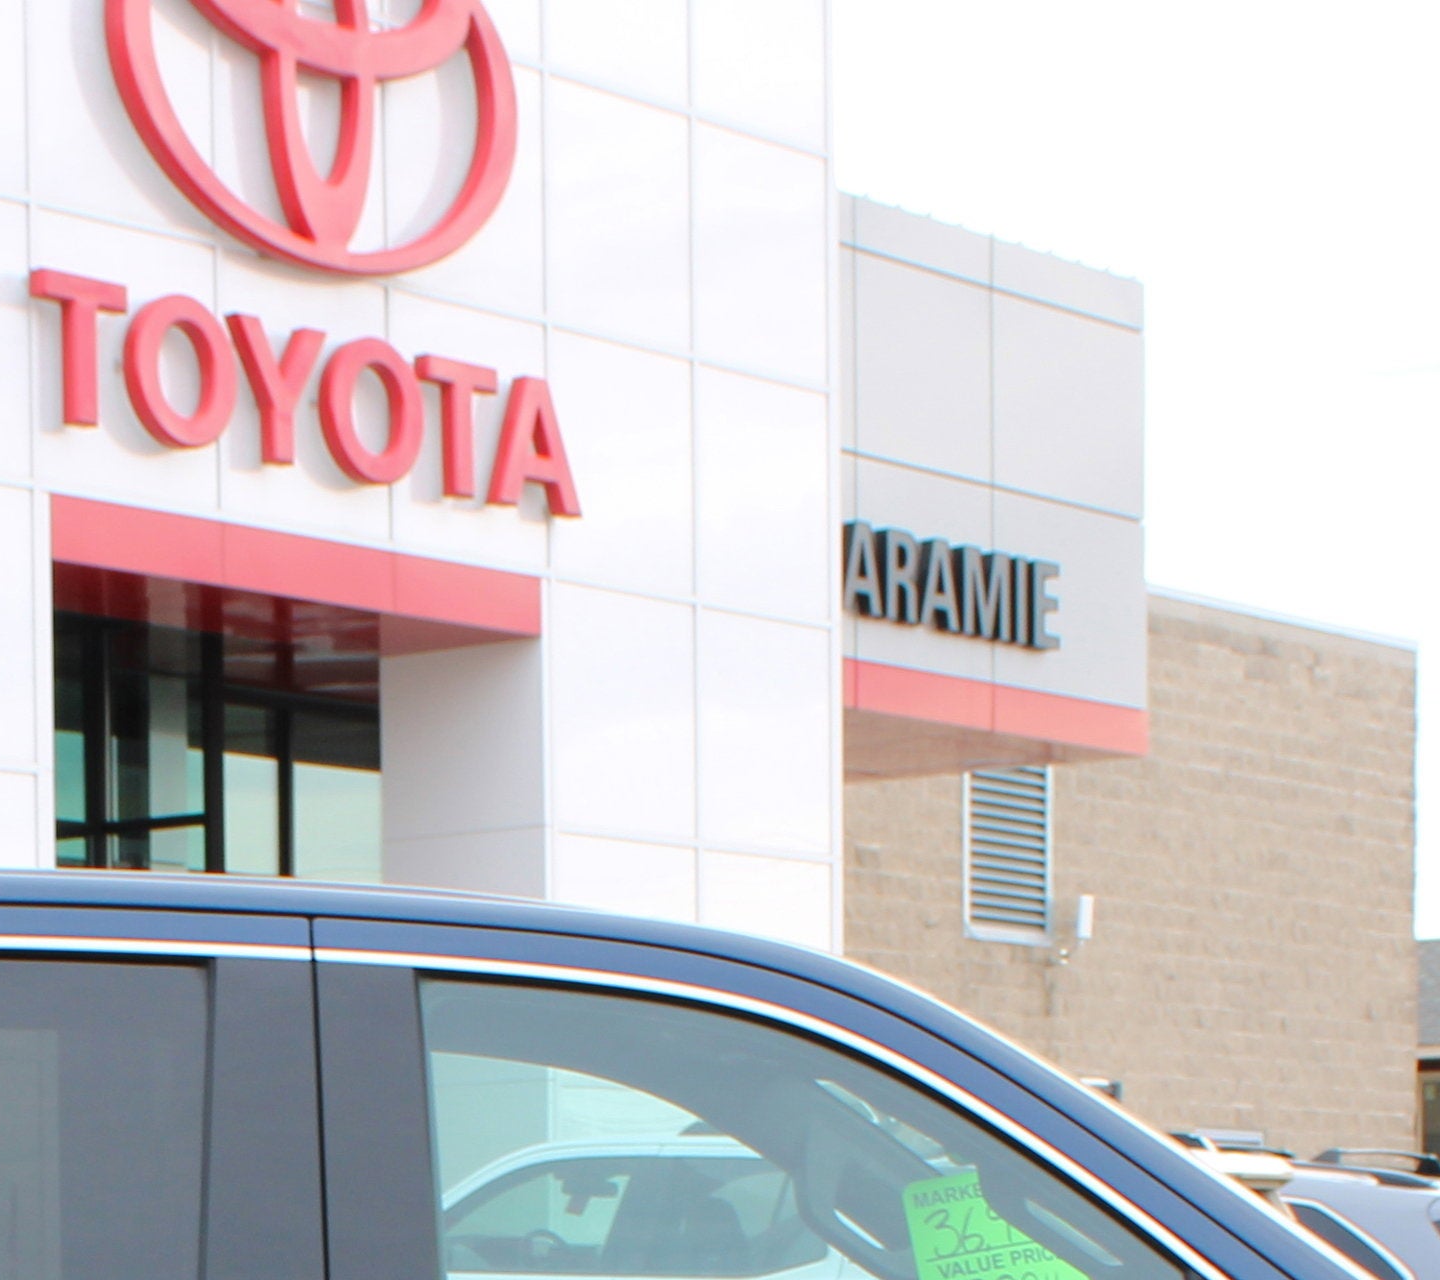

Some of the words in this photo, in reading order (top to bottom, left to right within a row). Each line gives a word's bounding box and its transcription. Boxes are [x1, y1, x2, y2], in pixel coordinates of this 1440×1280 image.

[29, 268, 582, 518] TOYOTA
[842, 519, 1062, 652] ARAMIE
[936, 1252, 1006, 1279] VALUE
